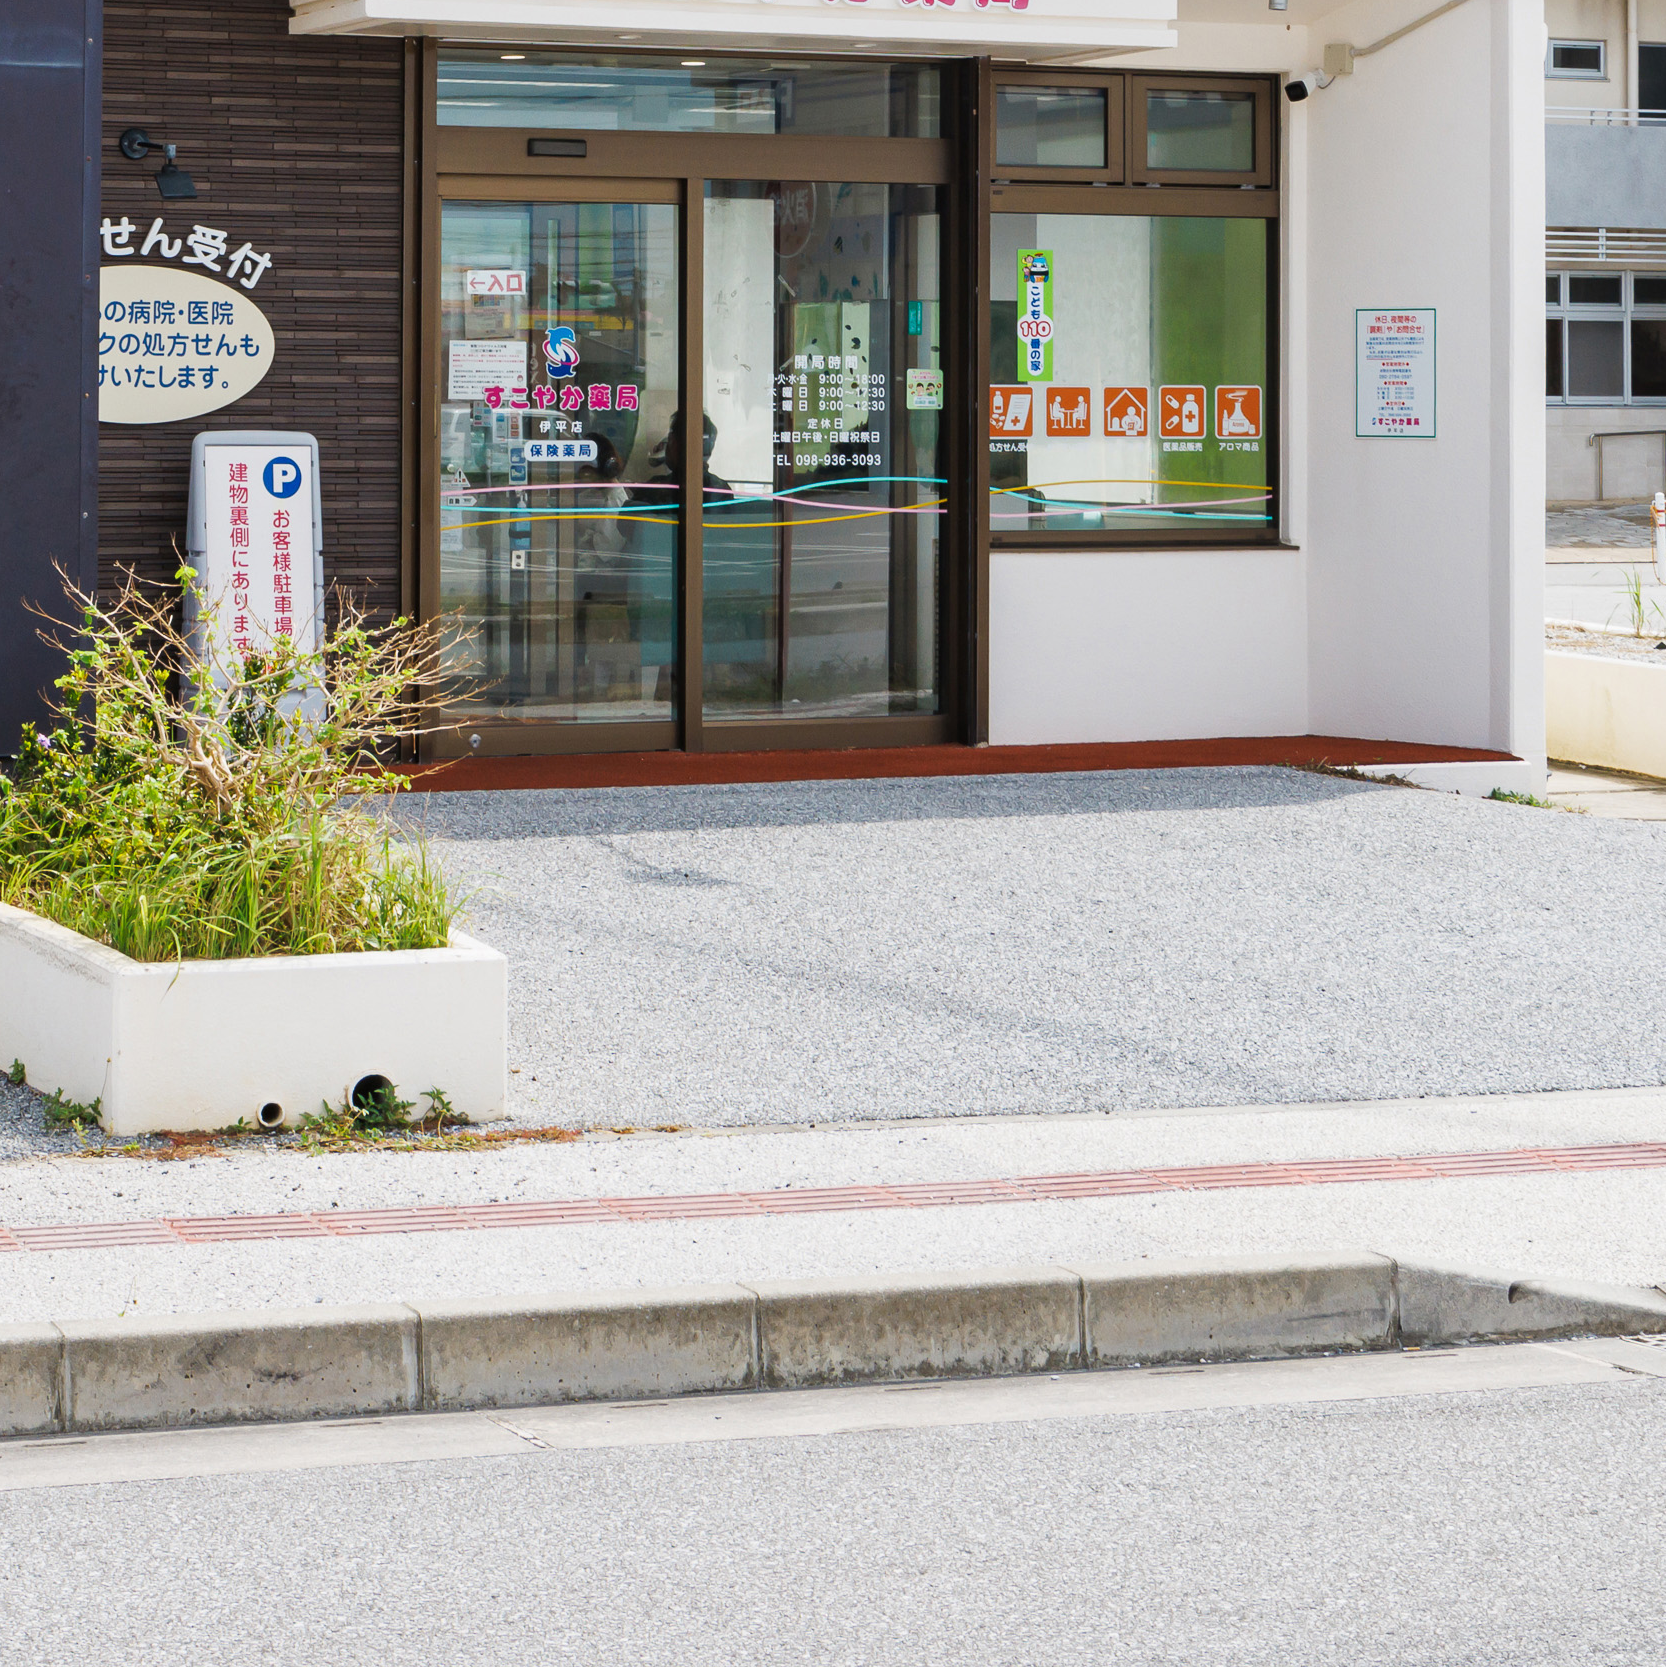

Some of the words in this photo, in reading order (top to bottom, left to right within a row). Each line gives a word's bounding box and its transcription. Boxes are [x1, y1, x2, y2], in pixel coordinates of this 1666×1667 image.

[487, 274, 523, 292] 入口
[99, 299, 234, 326] の病院・医院
[794, 355, 858, 370] 開局時間
[483, 384, 639, 411] すこやか薬局
[807, 418, 844, 430] 定休日
[529, 443, 592, 458] 保険薬局
[1218, 442, 1259, 453] アロマ商品
[772, 454, 792, 466] EL
[795, 454, 882, 466] 098-936-3093
[272, 463, 297, 493] P
